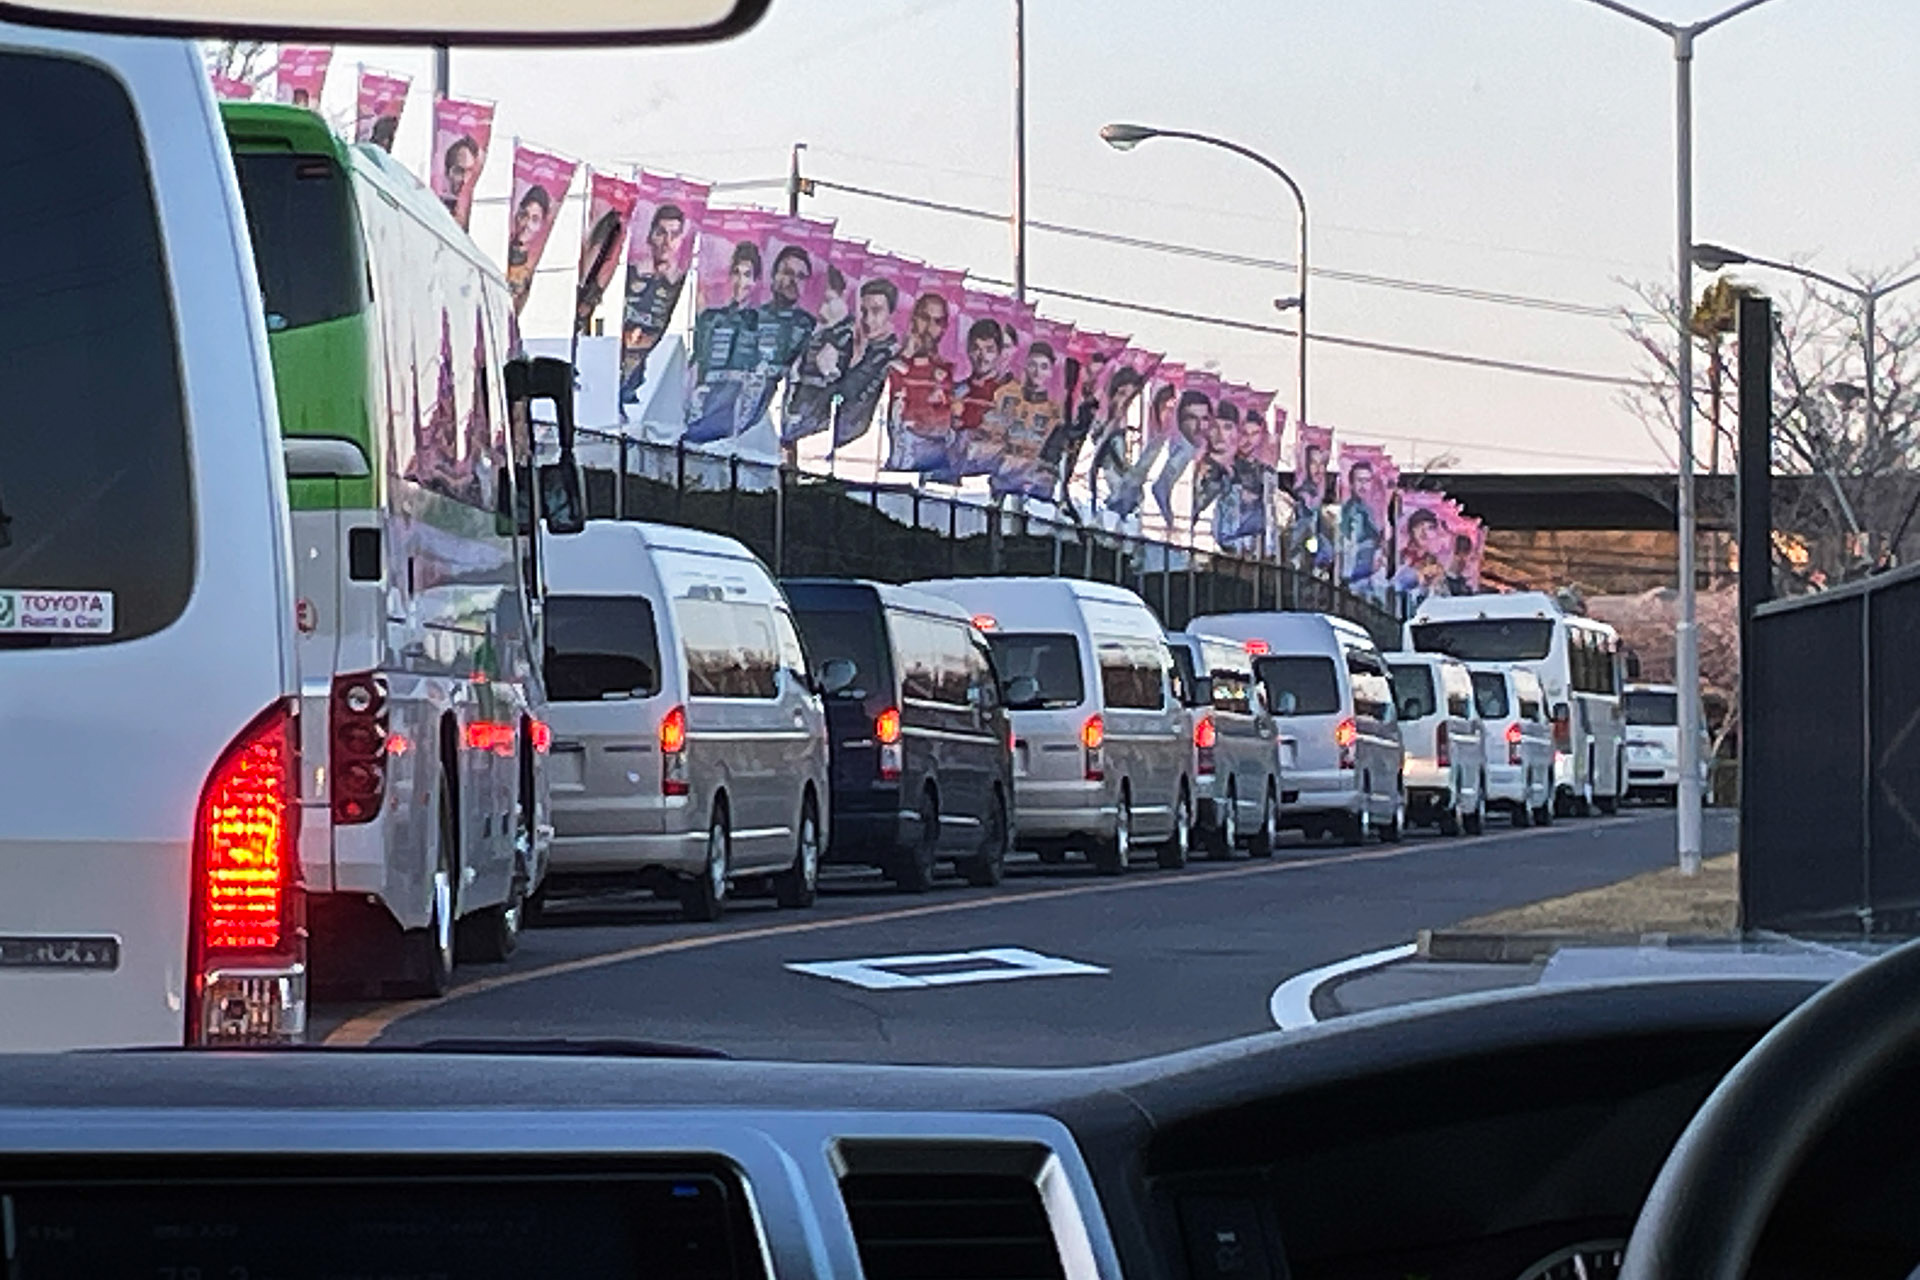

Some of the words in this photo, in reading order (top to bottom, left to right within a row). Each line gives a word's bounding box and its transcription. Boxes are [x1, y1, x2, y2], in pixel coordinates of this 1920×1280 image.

[21, 595, 104, 611] TOYOTA
[21, 614, 58, 628] Rent
[75, 614, 102, 628] Car
